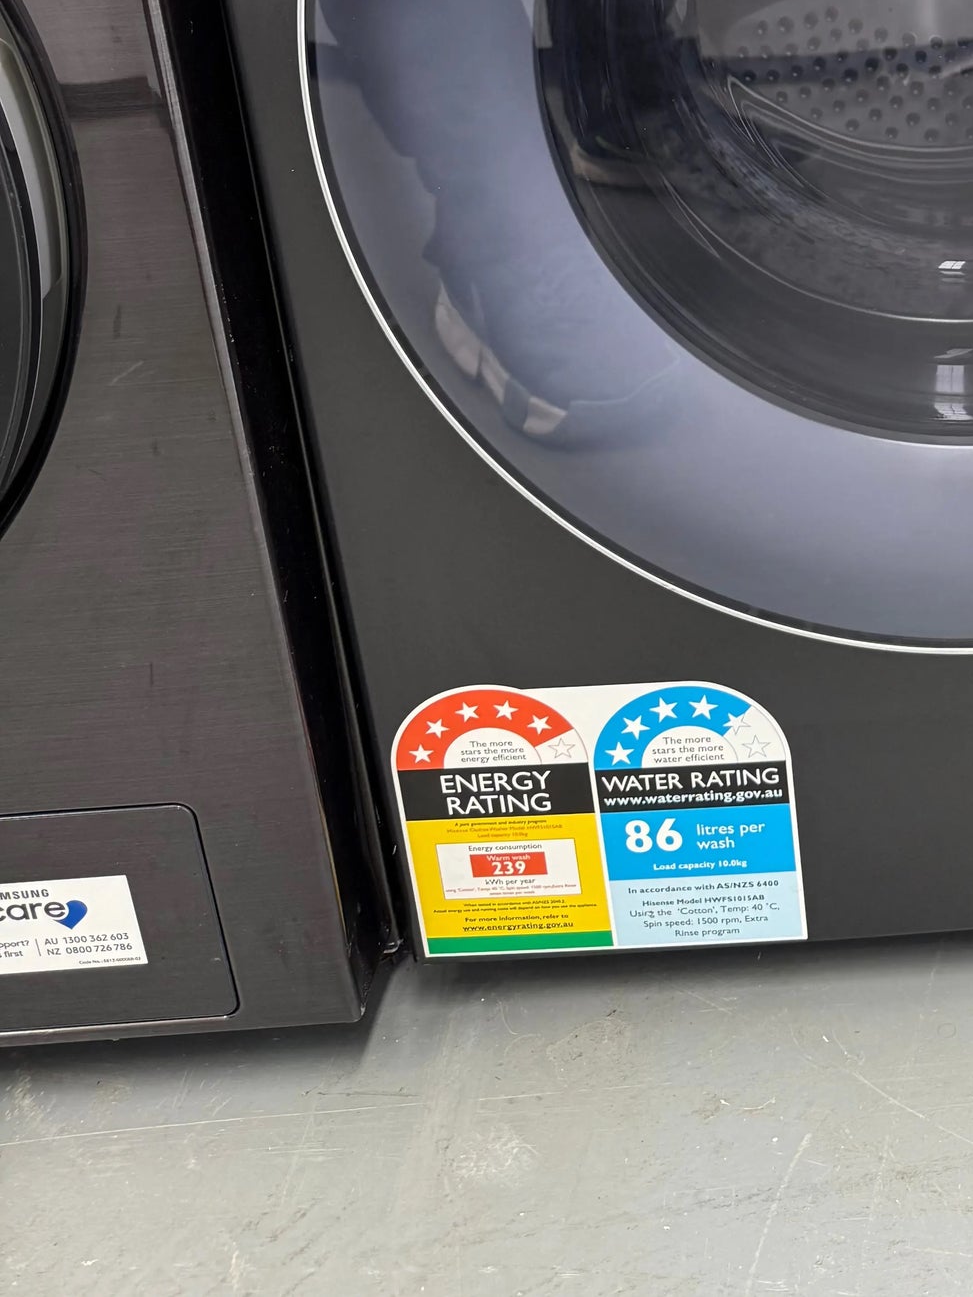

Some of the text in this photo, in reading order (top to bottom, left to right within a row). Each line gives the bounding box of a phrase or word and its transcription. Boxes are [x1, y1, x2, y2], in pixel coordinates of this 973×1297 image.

[663, 736, 711, 745] The more
[685, 753, 725, 761] efficient
[440, 771, 551, 794] ENERGY
[602, 768, 780, 792] WATER RATING
[604, 788, 782, 806] www.waterrating.gov.au
[446, 793, 551, 815] RATING
[625, 818, 683, 853] 86
[696, 823, 765, 836] litres per
[696, 837, 734, 850] wash
[492, 861, 526, 875] 239
[653, 859, 747, 871] Load capacity 10.0kg
[640, 885, 692, 893] accordance
[705, 895, 765, 903] HWFS1015AB
[630, 910, 654, 918] Using
[720, 905, 749, 913] Temp:
[463, 921, 573, 931] www.energyrating.gov.au
[644, 921, 662, 929] Spin
[63, 936, 87, 944] 1300
[89, 934, 107, 942] 362
[702, 929, 740, 937] program
[66, 946, 92, 954] 0800
